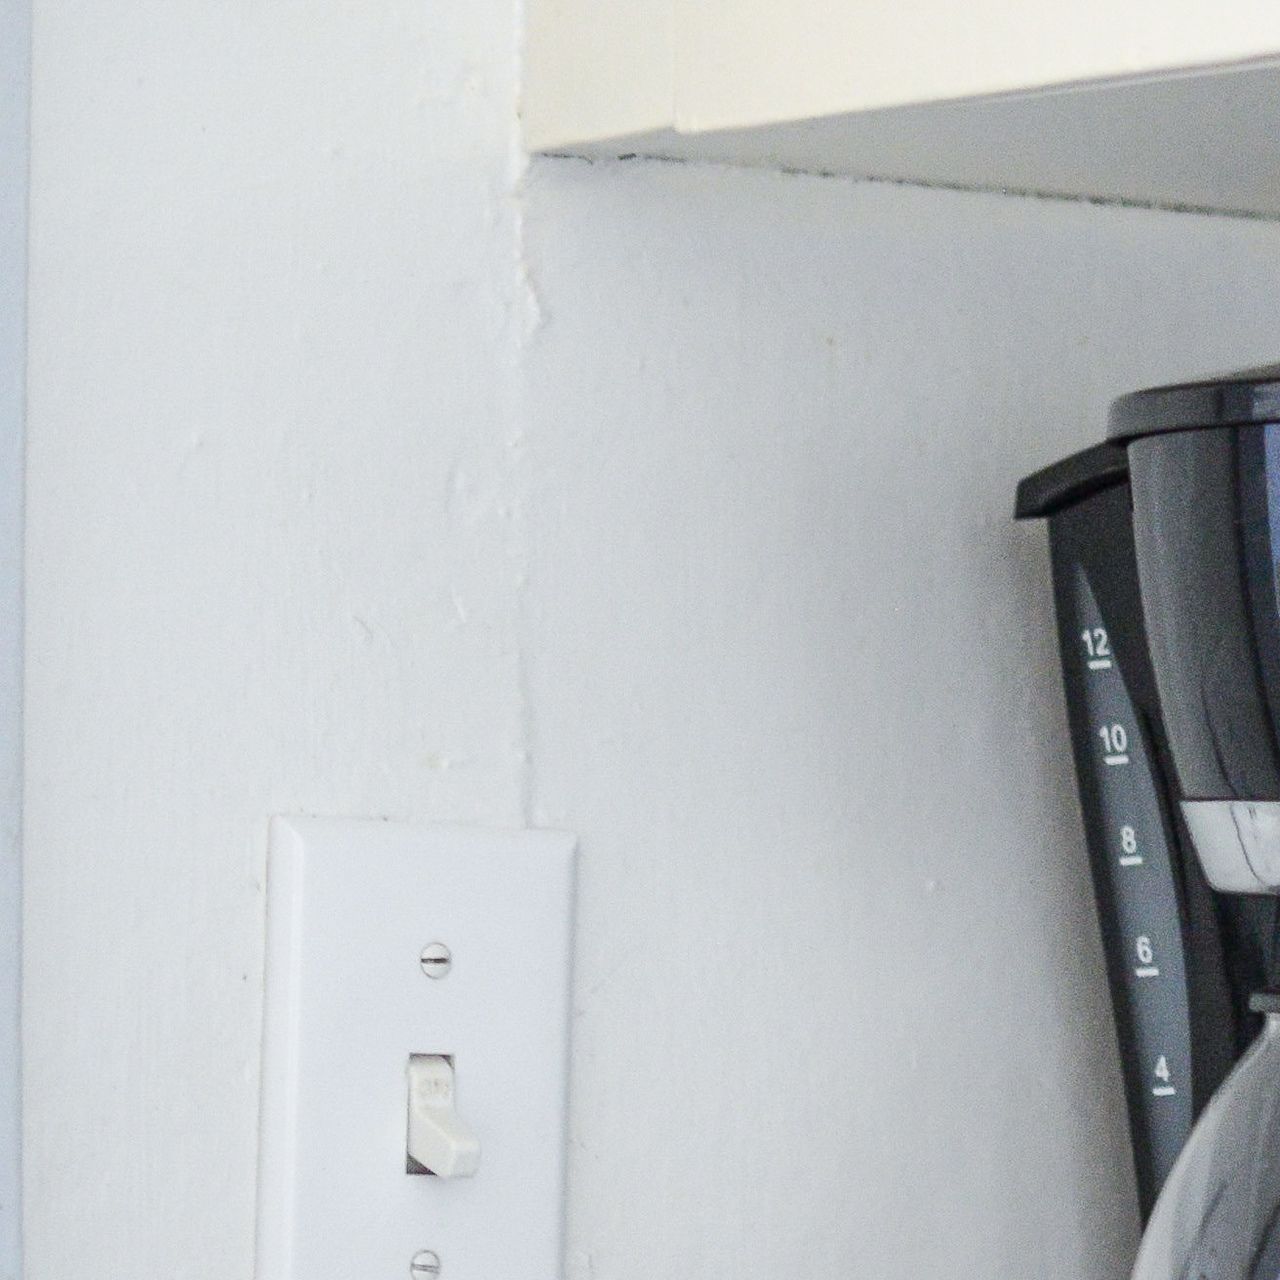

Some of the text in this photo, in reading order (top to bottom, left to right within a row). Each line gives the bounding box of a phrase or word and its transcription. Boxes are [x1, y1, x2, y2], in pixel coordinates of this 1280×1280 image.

[1082, 627, 1111, 657] 12
[1099, 723, 1128, 754] 10
[1120, 825, 1137, 854] 8
[1136, 935, 1153, 964] 6
[1154, 1055, 1170, 1083] 4
